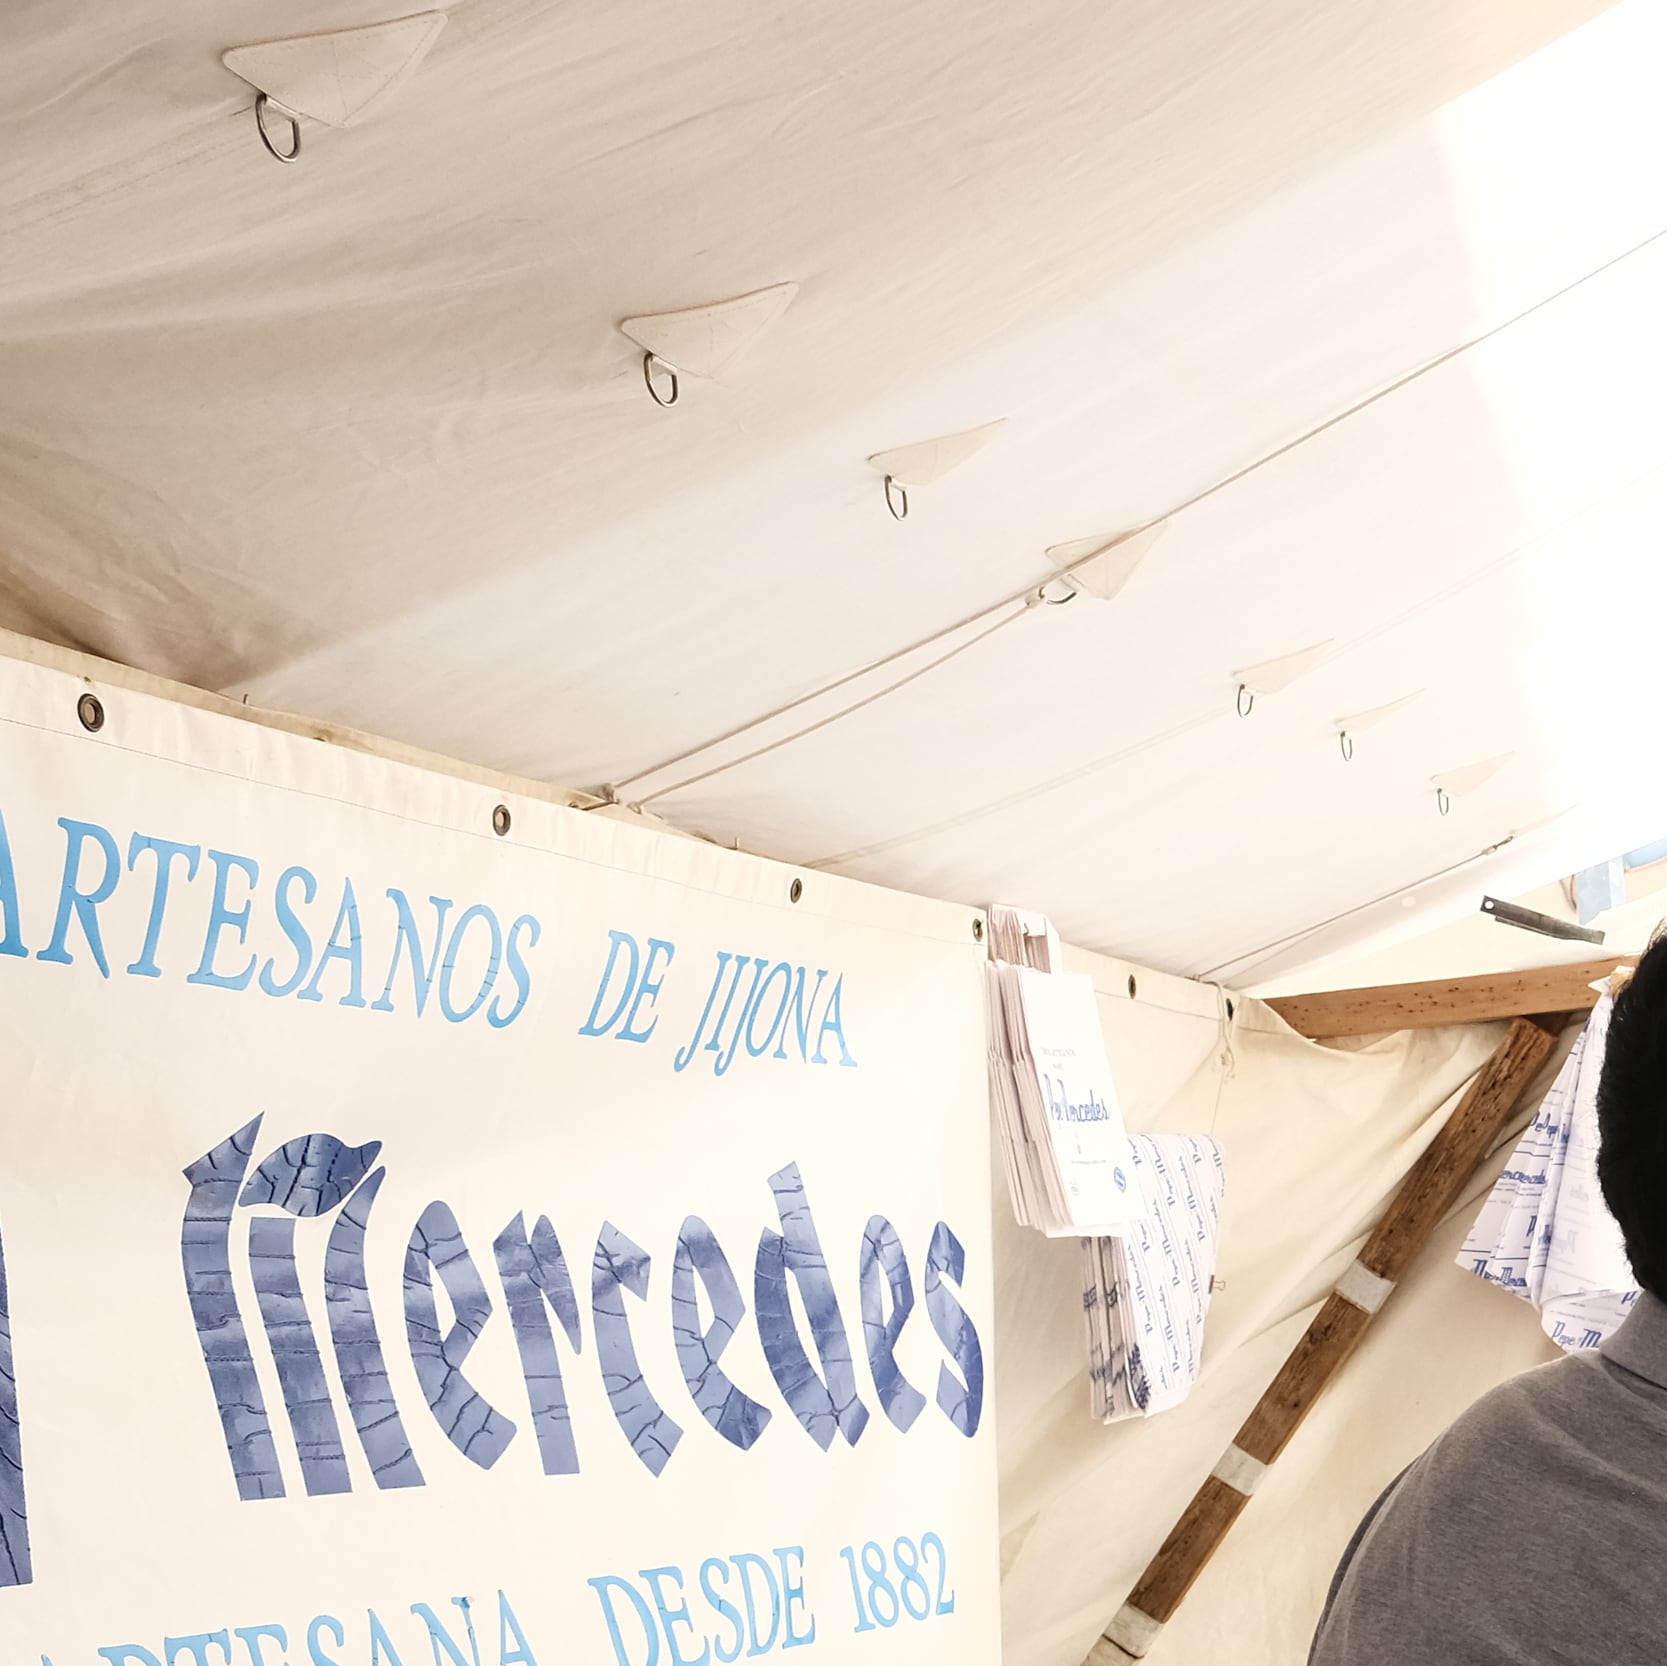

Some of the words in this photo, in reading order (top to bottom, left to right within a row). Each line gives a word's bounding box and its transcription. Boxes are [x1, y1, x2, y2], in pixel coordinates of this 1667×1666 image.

[577, 927, 675, 1045] DE
[675, 952, 859, 1075] JIJONA
[183, 1110, 985, 1502] Mercedes
[840, 1530, 956, 1633] 1882
